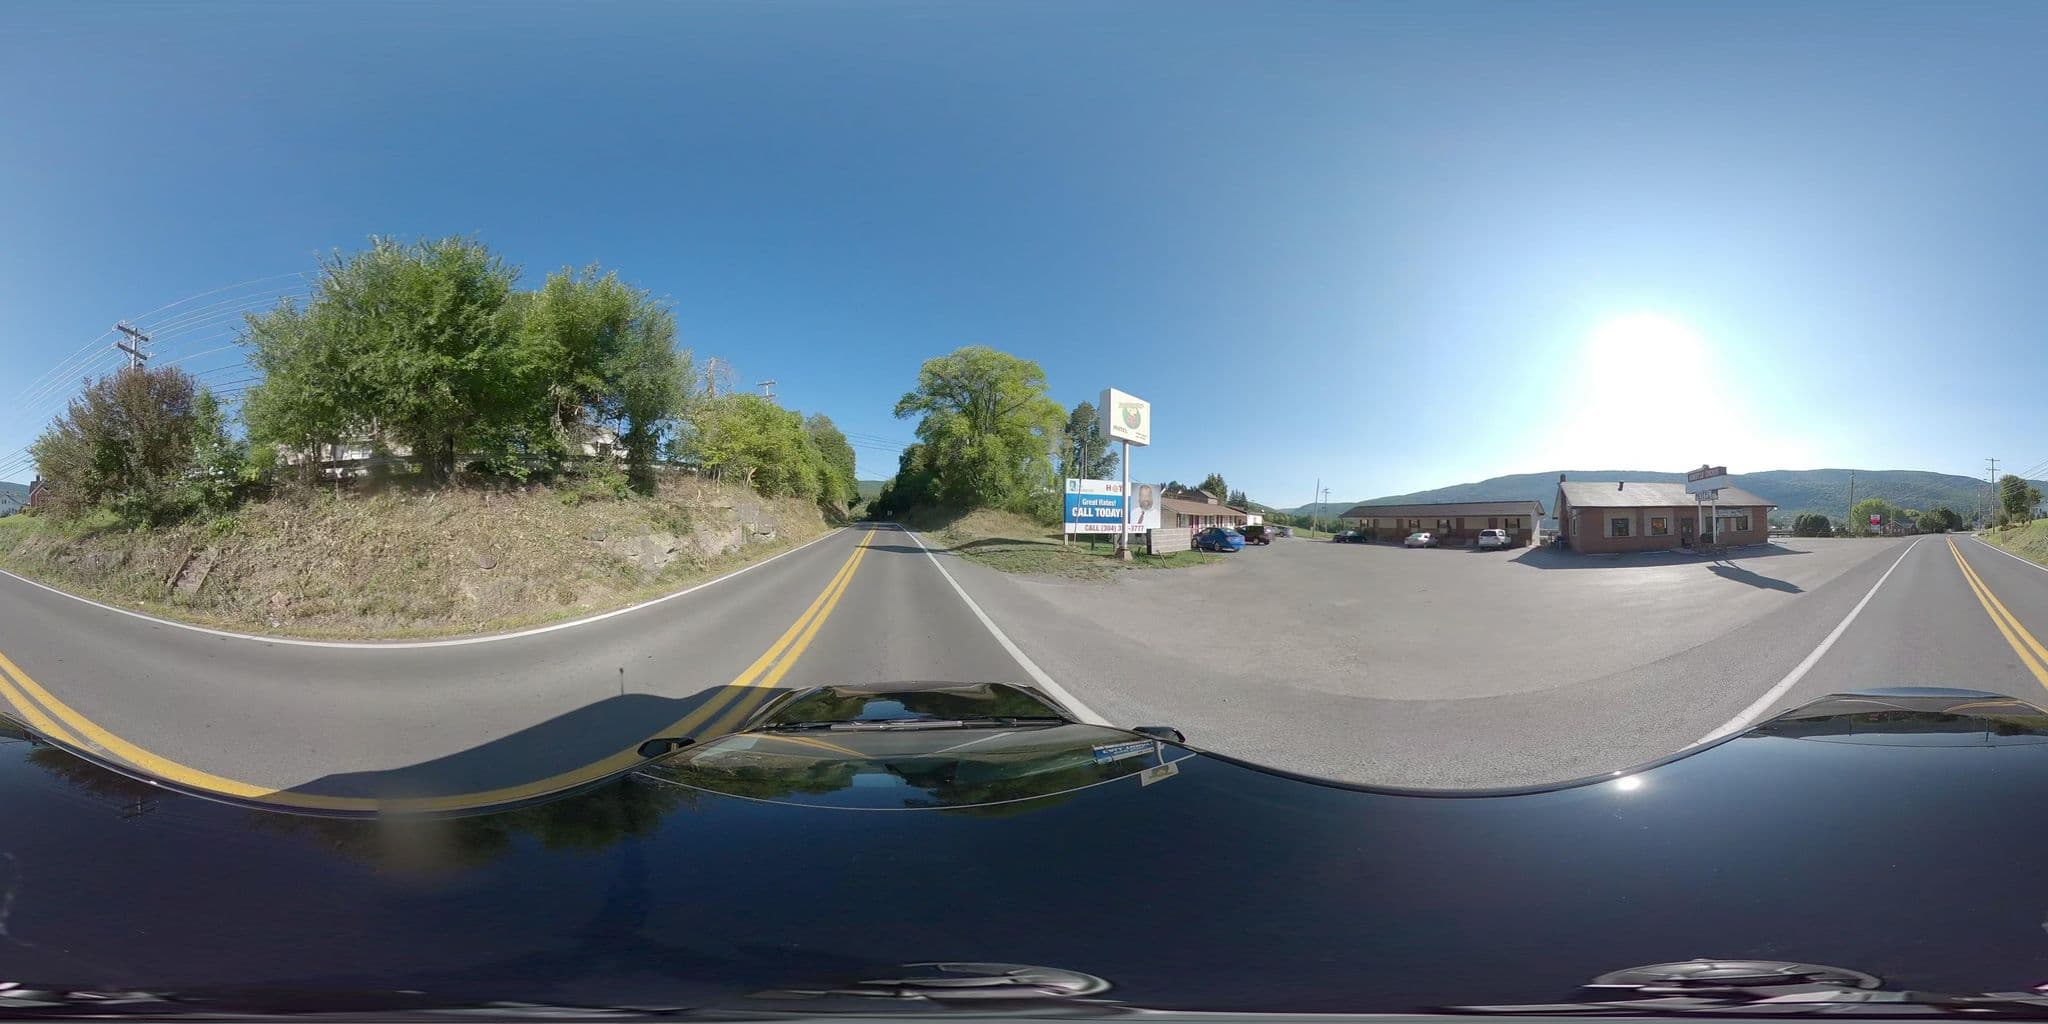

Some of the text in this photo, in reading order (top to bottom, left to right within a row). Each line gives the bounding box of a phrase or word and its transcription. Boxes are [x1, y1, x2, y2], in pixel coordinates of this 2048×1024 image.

[1082, 498, 1116, 507] Great Rates!
[1072, 507, 1123, 518] CALL TODAY!
[1085, 524, 1099, 532] CALL
